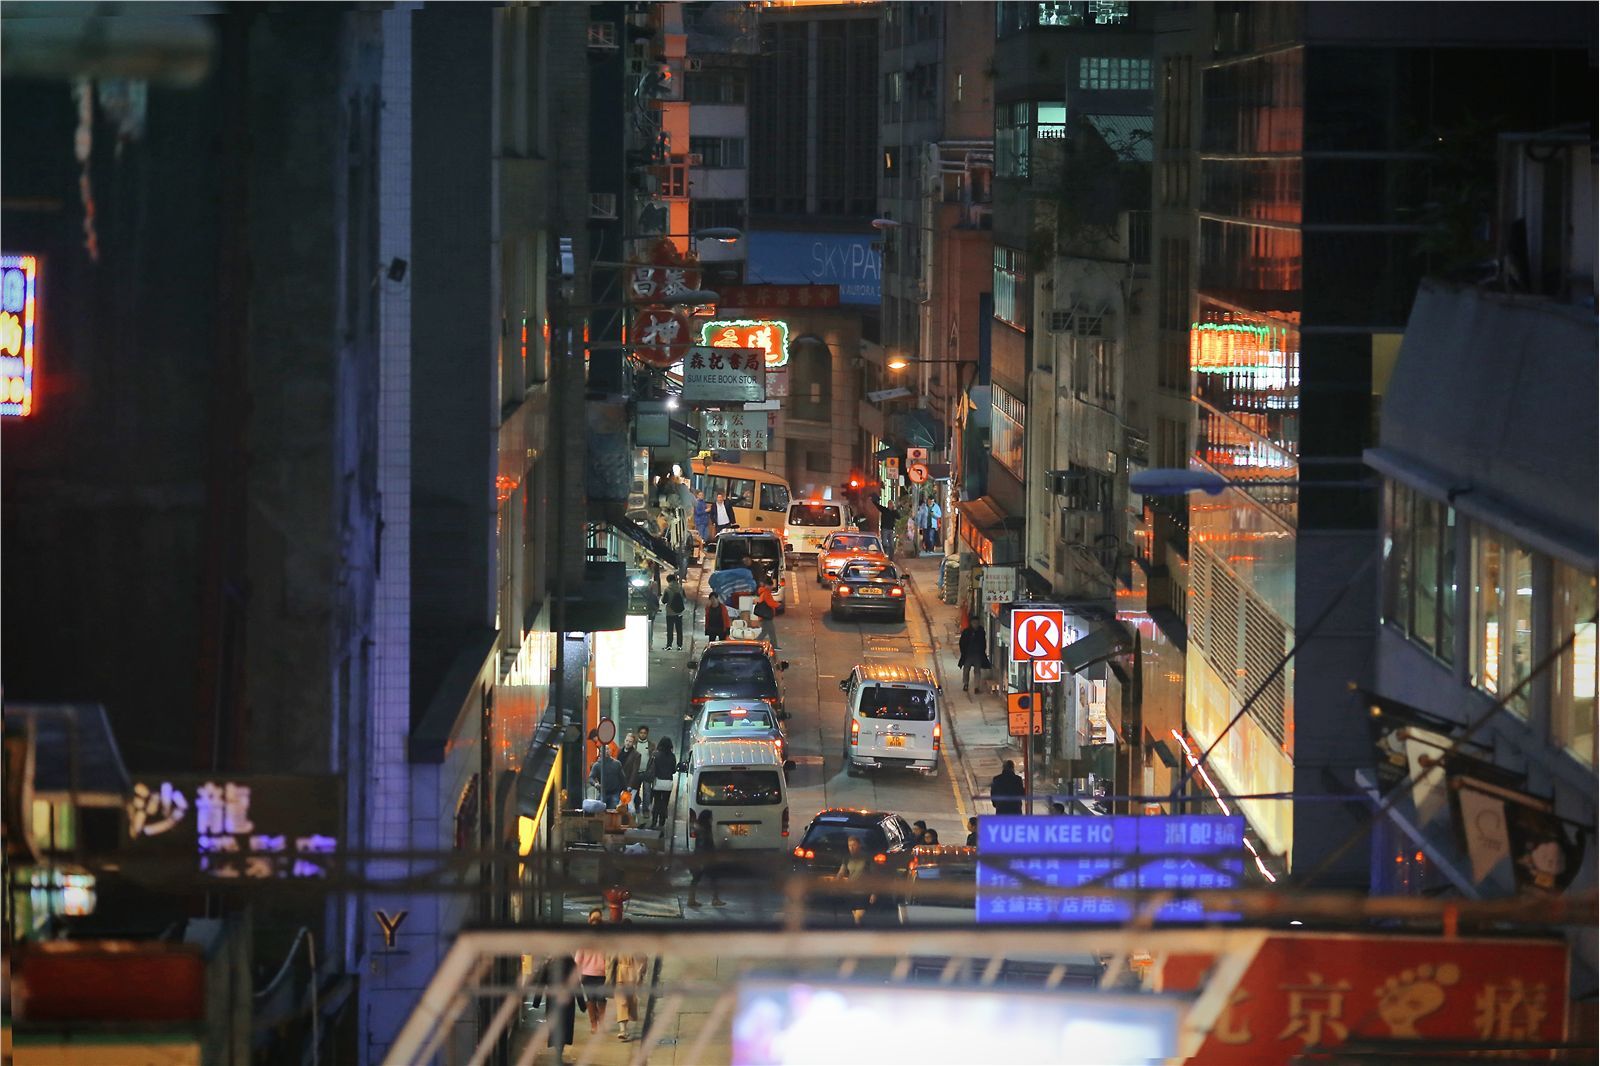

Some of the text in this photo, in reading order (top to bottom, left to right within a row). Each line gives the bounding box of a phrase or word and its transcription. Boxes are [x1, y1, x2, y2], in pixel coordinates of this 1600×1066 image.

[690, 352, 759, 371] 森記書局
[687, 374, 702, 383] SUM
[704, 374, 718, 384] KEE
[719, 374, 737, 384] BOOK
[128, 782, 254, 838] 沙龍
[987, 824, 1113, 844] YUEN KEE HO
[376, 911, 407, 948] Y
